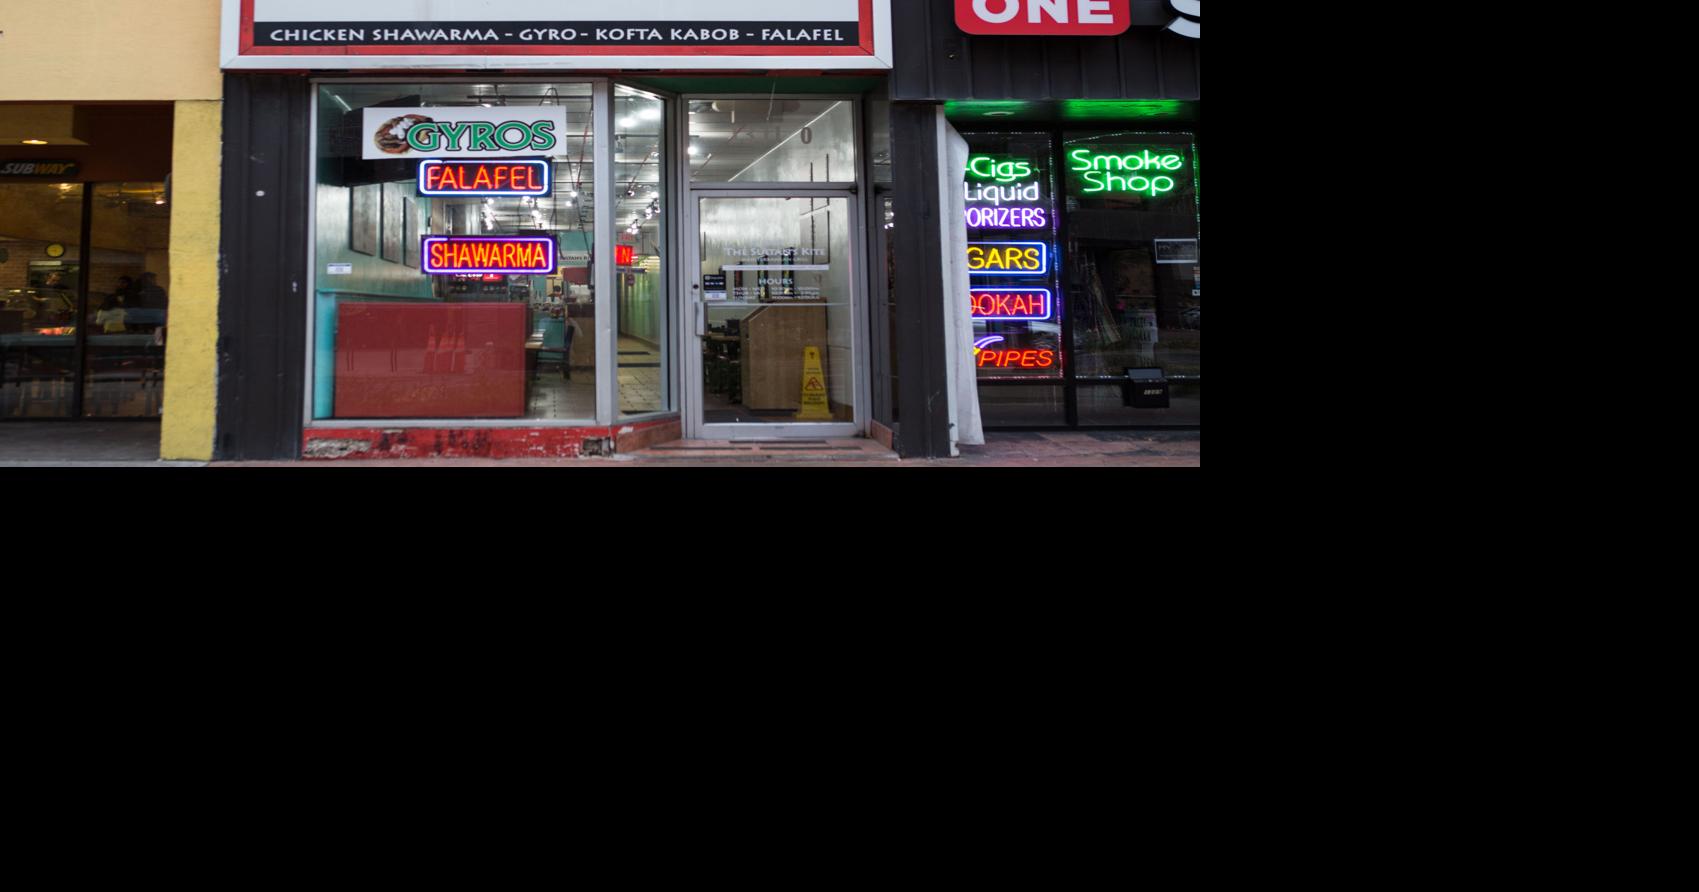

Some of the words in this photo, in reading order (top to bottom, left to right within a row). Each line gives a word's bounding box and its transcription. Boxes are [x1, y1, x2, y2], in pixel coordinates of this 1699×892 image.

[971, 0, 1114, 24] ONE
[270, 29, 364, 41] CHICKEN
[373, 29, 499, 41] SHAWARMA
[519, 28, 576, 41] GYRO
[596, 28, 663, 40] KOFTA
[670, 28, 739, 40] KABOB
[762, 28, 844, 41] FALAFEL
[406, 120, 556, 152] GYROS
[0, 163, 75, 174] SUBWAY
[1071, 149, 1182, 171] Smoke
[427, 165, 543, 190] FALAFEL
[1083, 170, 1174, 197] Shop
[964, 181, 1039, 206] Liquid
[964, 207, 1046, 227] ORIZERS
[430, 243, 547, 268] SHAWARMA
[724, 248, 748, 256] THE
[801, 248, 826, 256] KITE
[967, 247, 1040, 270] GARS
[978, 350, 1054, 368] PIPES
